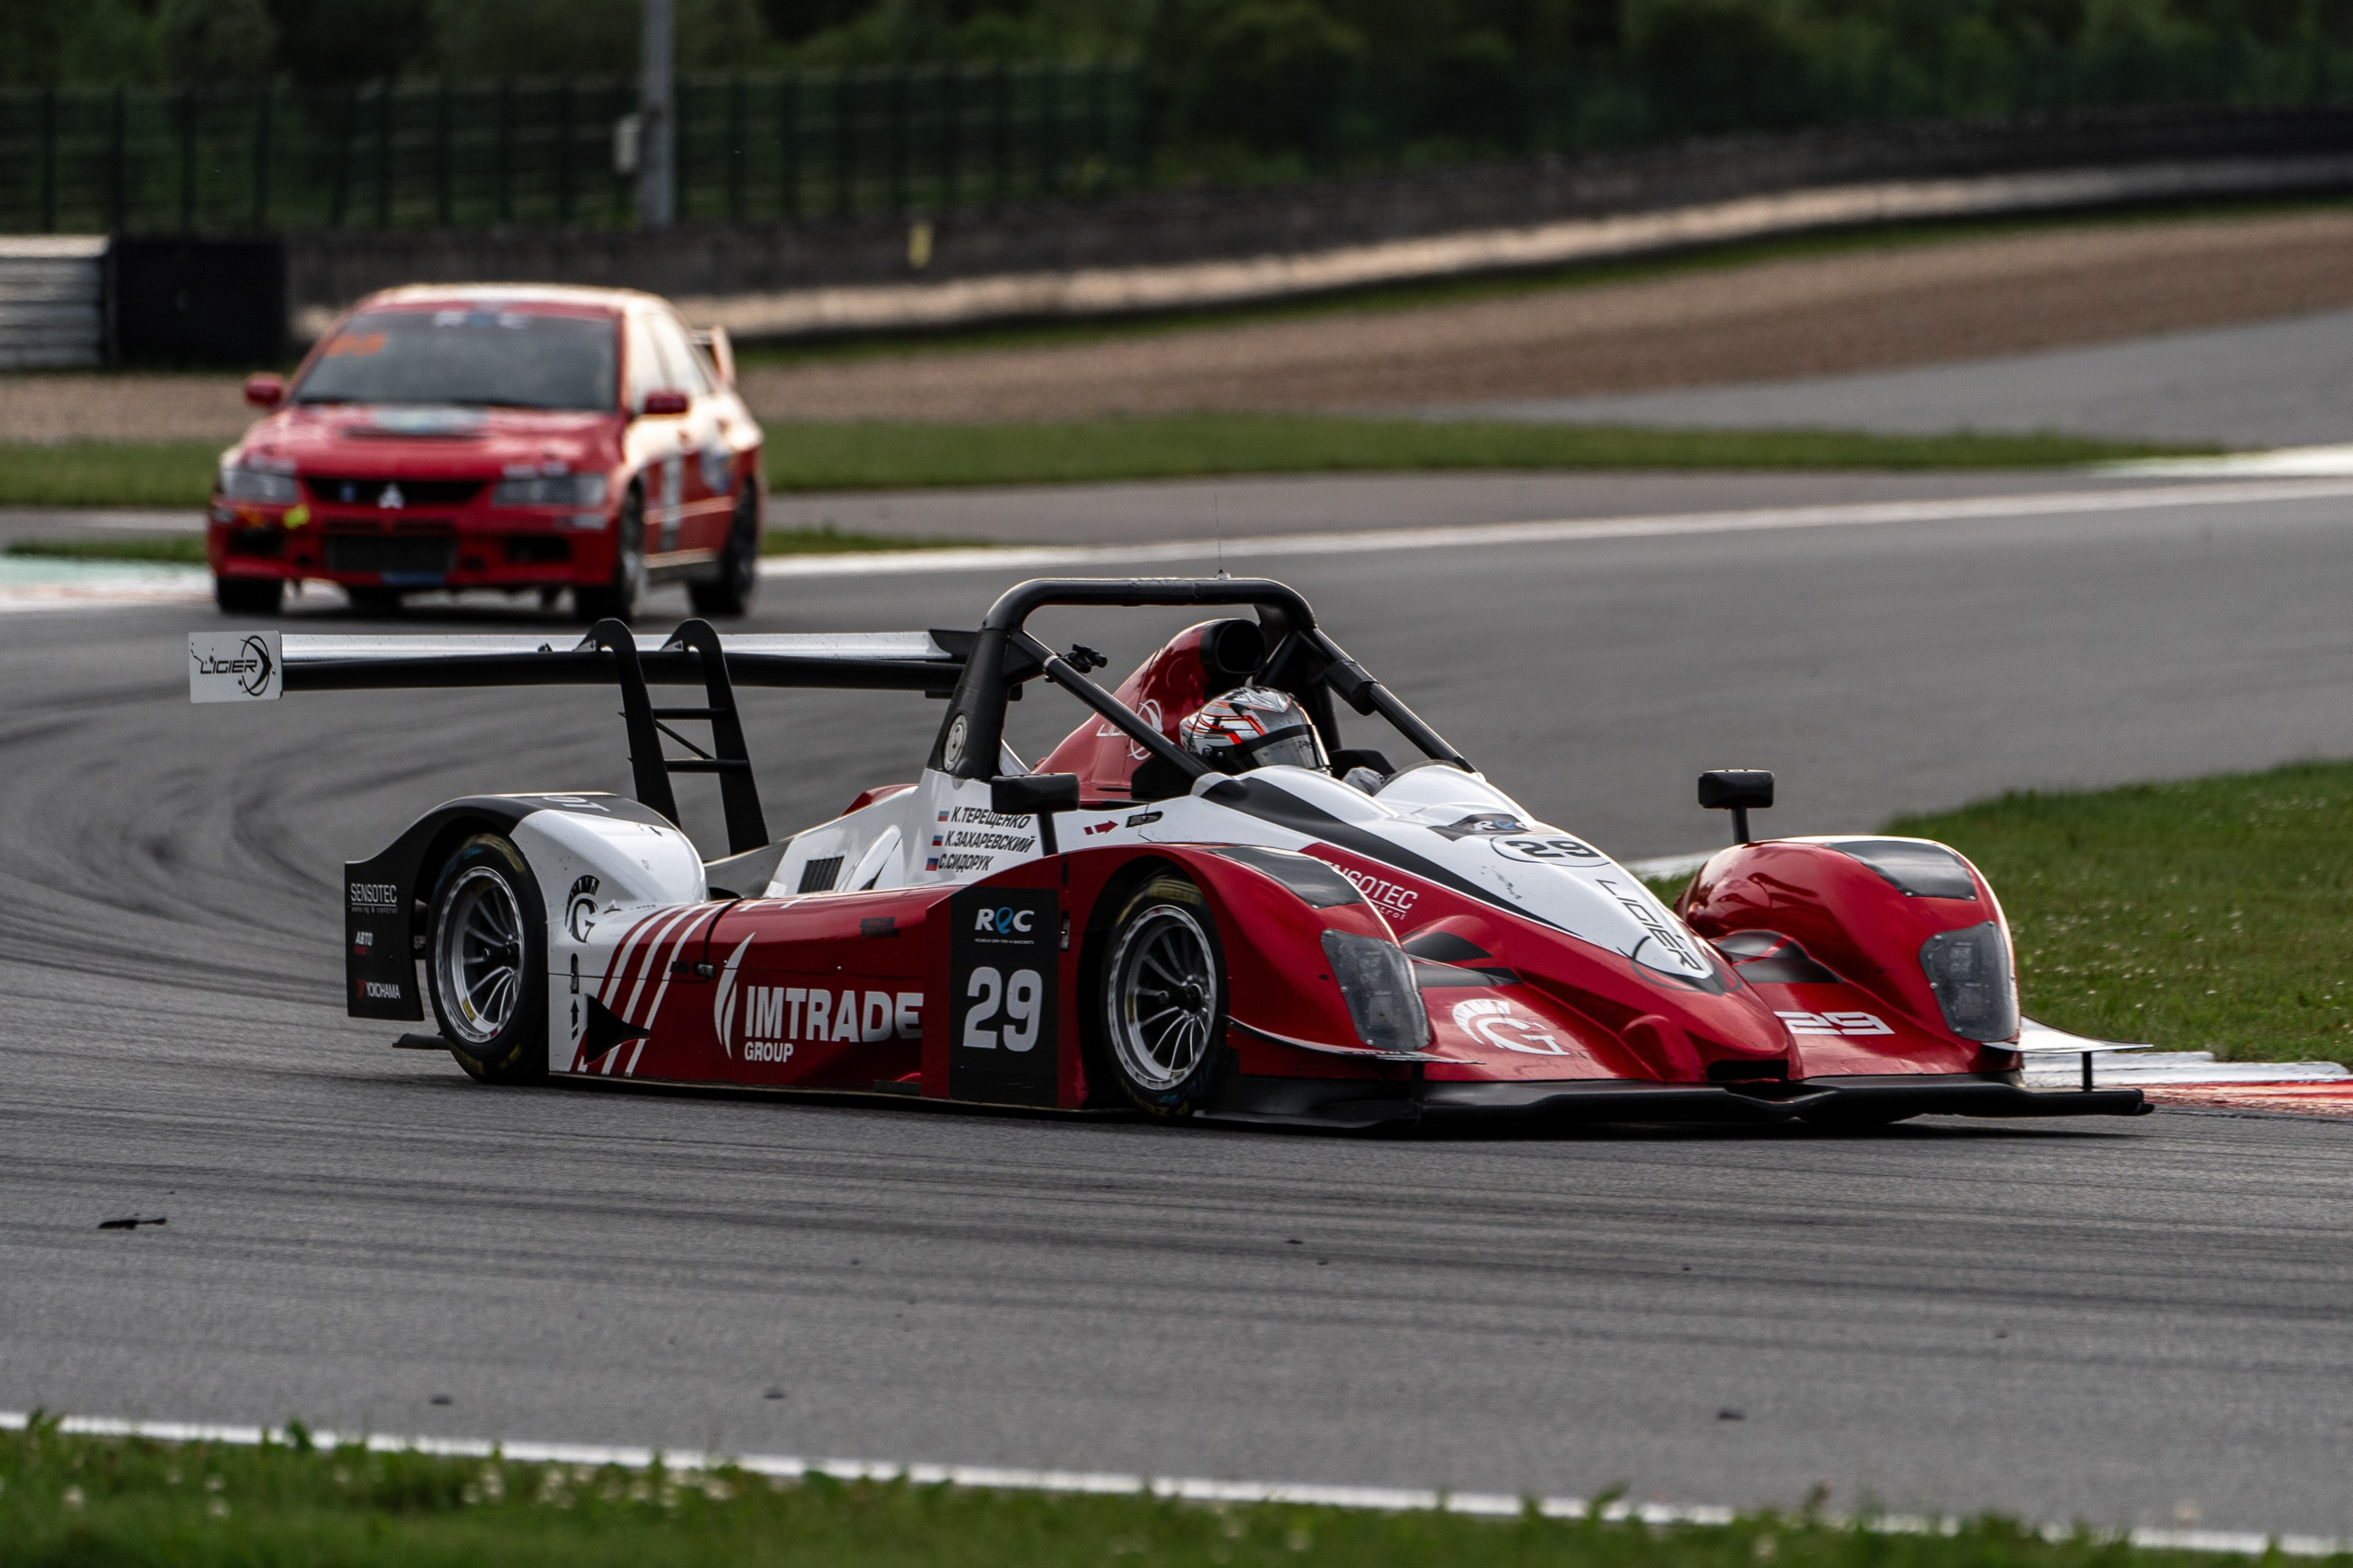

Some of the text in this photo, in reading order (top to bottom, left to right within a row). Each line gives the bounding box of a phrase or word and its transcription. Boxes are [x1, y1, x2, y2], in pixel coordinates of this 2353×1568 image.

[200, 659, 257, 675] LIGIER
[945, 830, 1036, 853] К.ЗАХАРЕВСКИЙ
[1504, 840, 1601, 858] 29
[938, 853, 994, 872] С.СИДОРУК
[351, 882, 397, 903] SENSOTEC
[1595, 879, 1704, 971] LIGIER
[365, 982, 401, 999] YOKOHAMA
[745, 985, 924, 1042] IMTRADE
[962, 966, 1042, 1052] 29
[1773, 1011, 1896, 1036] 29
[745, 1041, 794, 1062] GROUP
